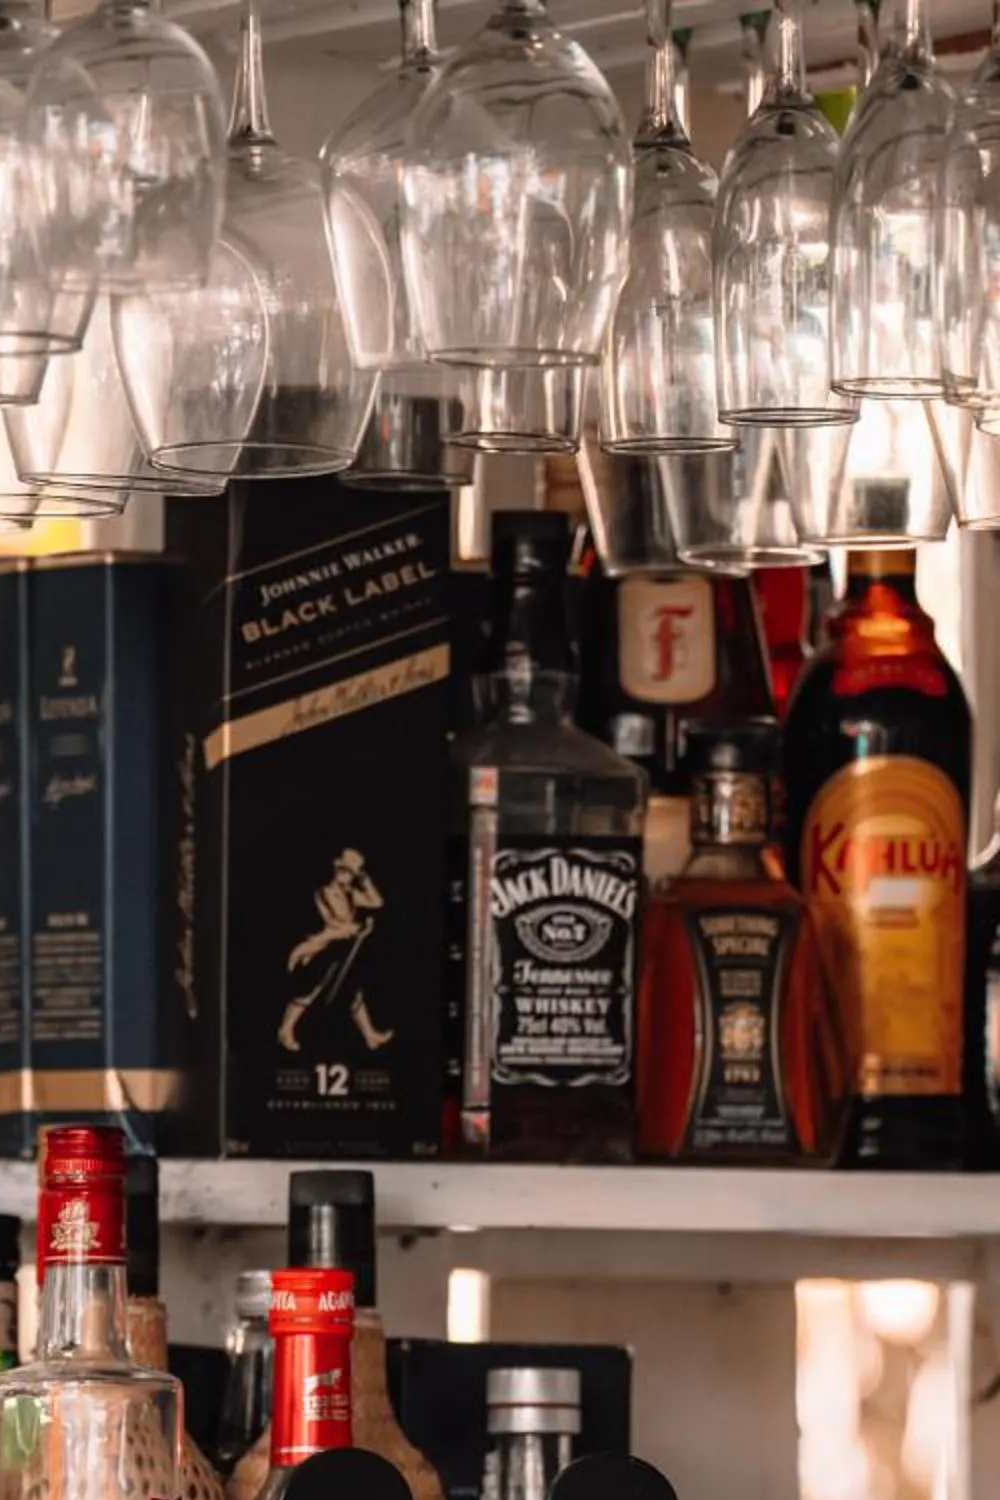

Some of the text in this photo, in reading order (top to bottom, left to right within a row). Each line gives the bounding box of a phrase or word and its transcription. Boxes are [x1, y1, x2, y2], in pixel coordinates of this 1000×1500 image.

[260, 533, 420, 607] JOHNNIE WALKER
[240, 594, 338, 645] BLACK
[343, 561, 437, 606] LABEL
[489, 866, 550, 918] JACK
[514, 997, 611, 1015] WHISKEY
[314, 1064, 349, 1096] 12
